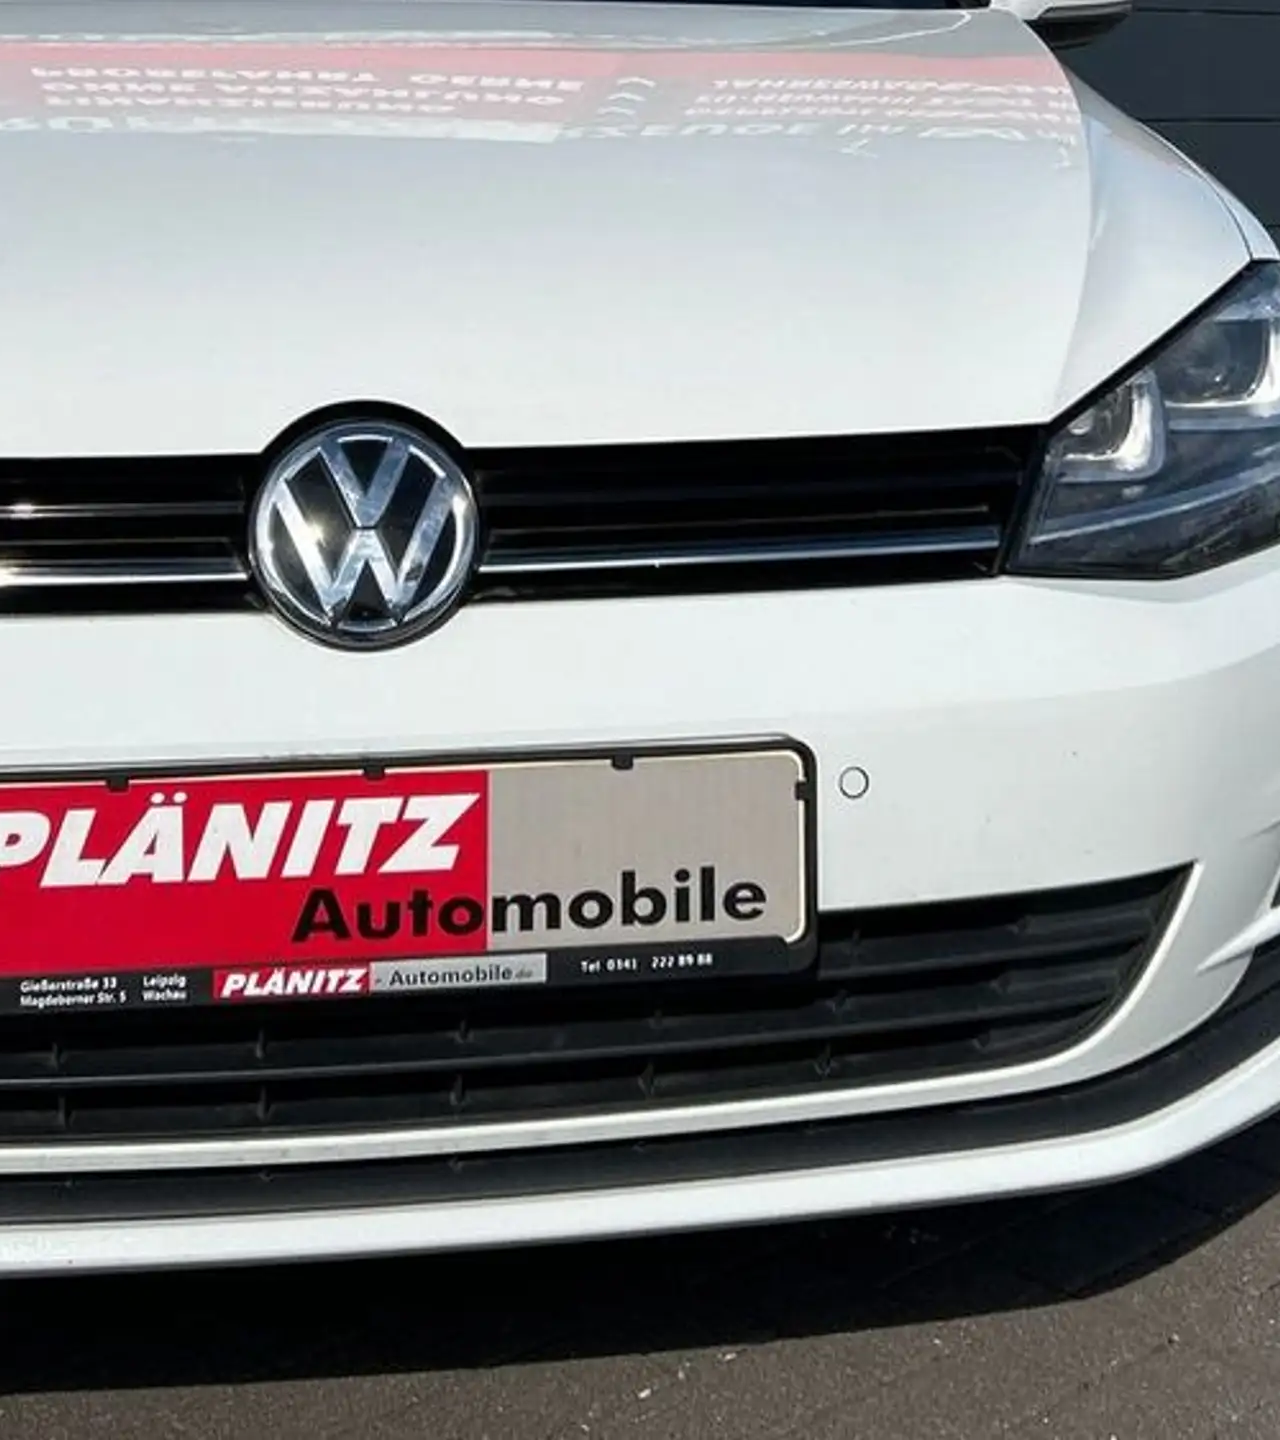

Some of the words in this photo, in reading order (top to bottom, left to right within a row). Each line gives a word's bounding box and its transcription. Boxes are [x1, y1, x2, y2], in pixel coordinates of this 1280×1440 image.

[292, 867, 766, 943] Automobile
[143, 974, 187, 989] Leipzig
[220, 967, 367, 998] PLÄNITZ
[143, 990, 187, 1001] Wachau
